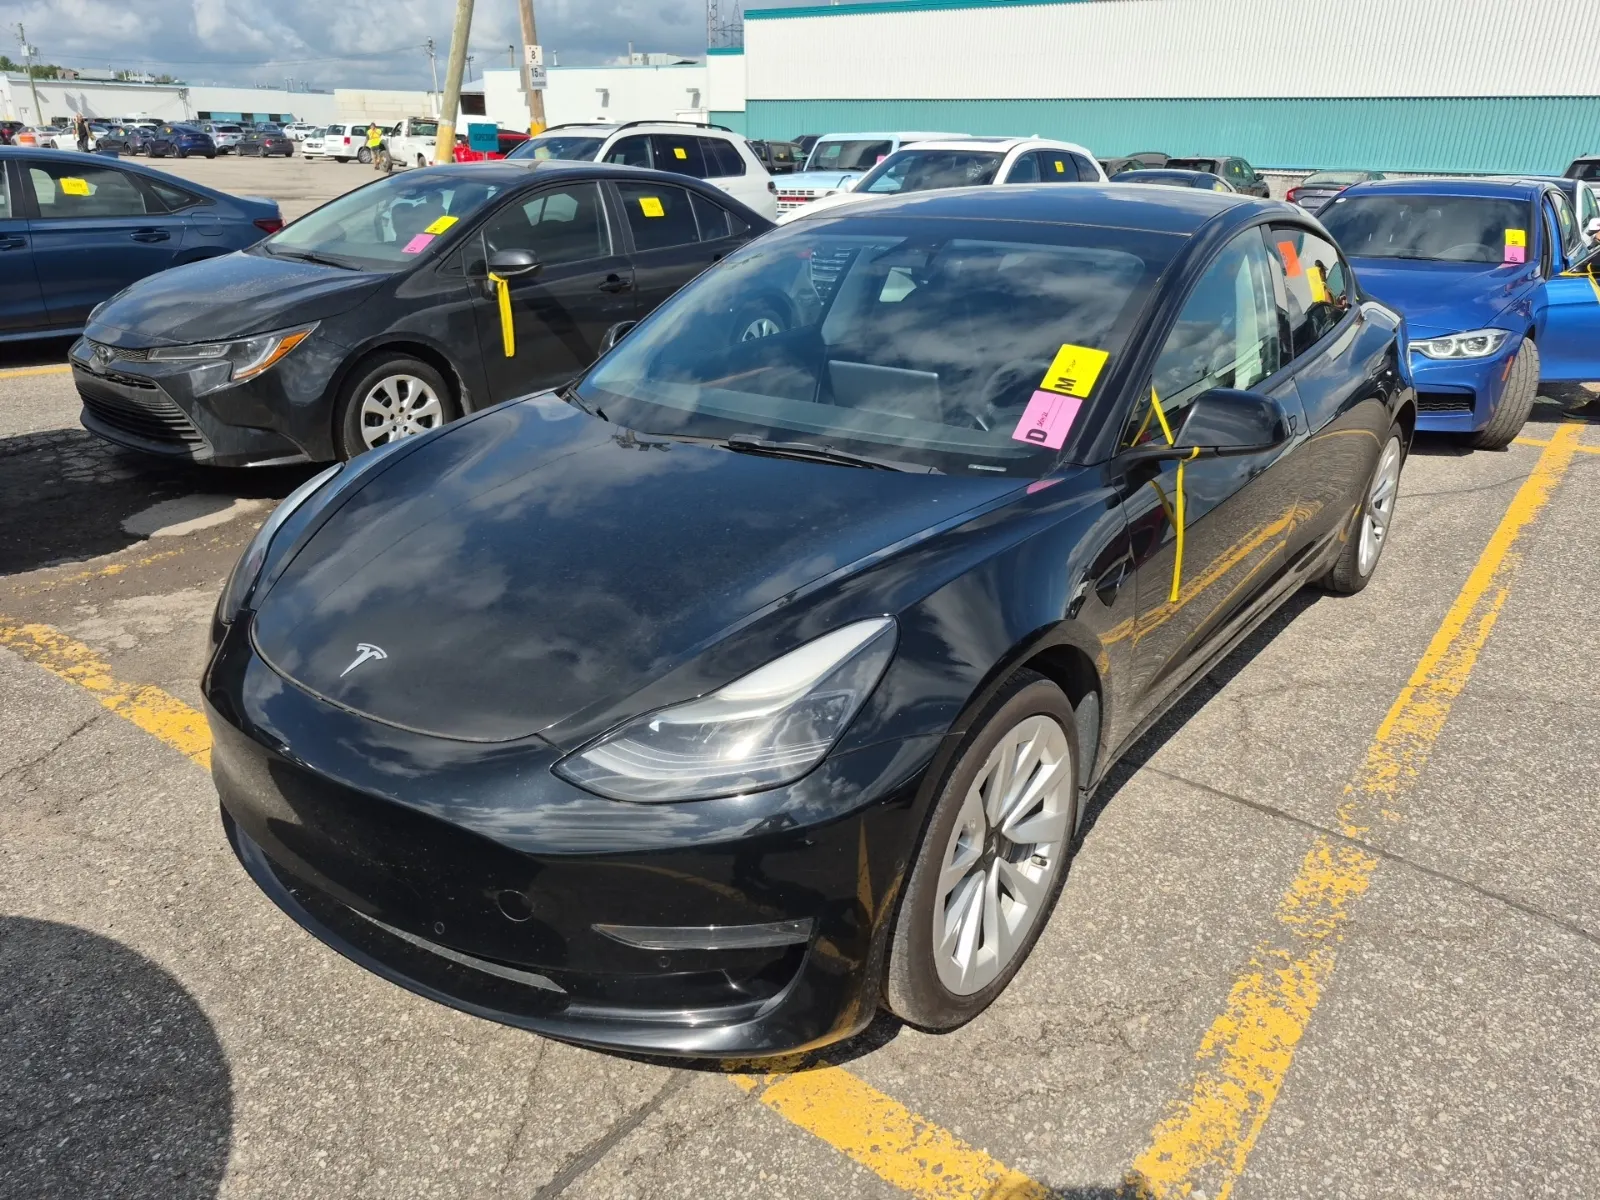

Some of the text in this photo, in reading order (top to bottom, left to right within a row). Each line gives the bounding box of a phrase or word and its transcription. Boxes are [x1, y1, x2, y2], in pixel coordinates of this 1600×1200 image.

[531, 50, 536, 60] 8
[531, 67, 539, 77] 15
[1054, 376, 1077, 391] M
[1025, 428, 1048, 443] D
